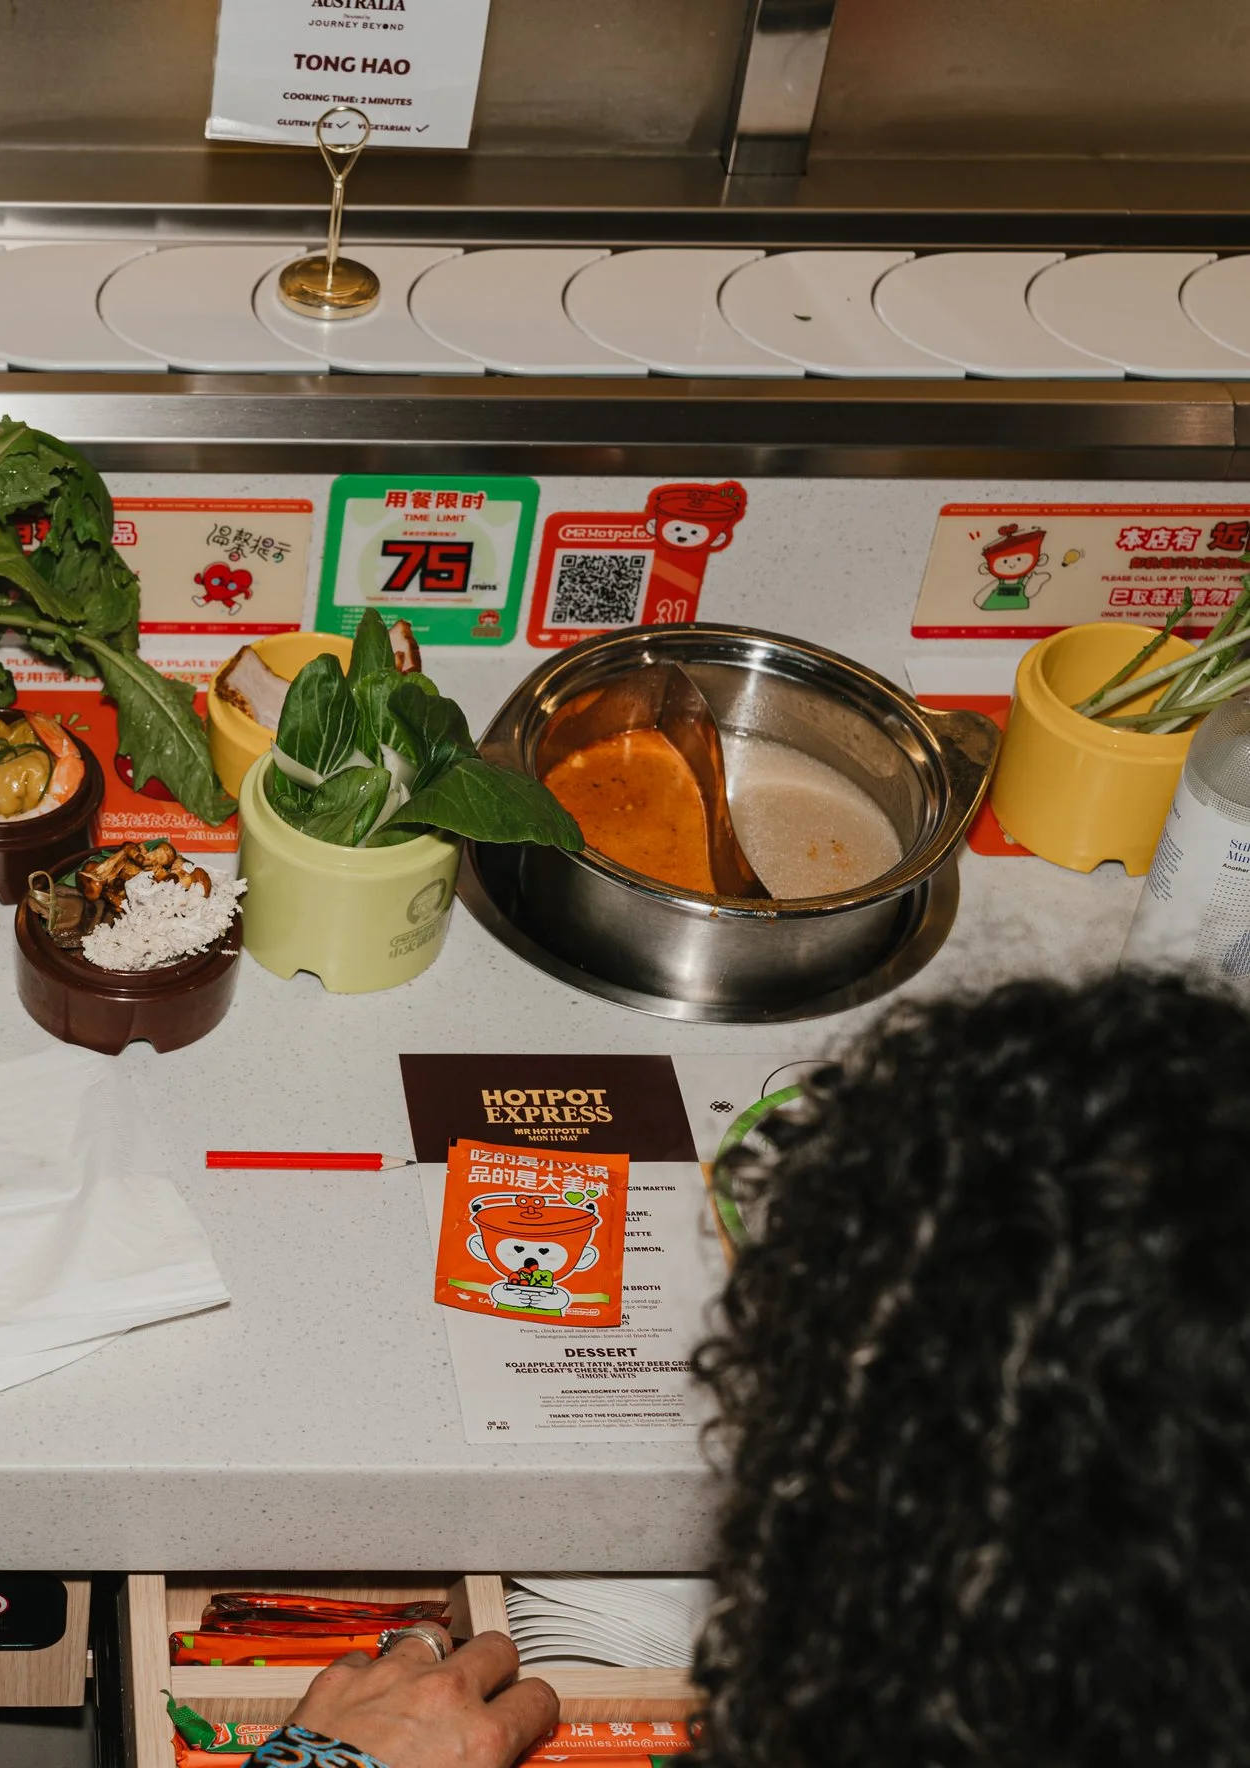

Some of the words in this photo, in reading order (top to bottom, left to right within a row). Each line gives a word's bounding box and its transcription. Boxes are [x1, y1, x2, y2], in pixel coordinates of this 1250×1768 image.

[311, 0, 406, 11] AUSTRALIA
[308, 20, 358, 28] JOURNEY
[362, 22, 404, 30] BEYOND
[293, 53, 356, 72] TONG
[361, 58, 411, 75] HAO
[283, 92, 330, 103] COOKING
[332, 94, 359, 104] TIME:
[360, 96, 367, 104] 2
[368, 97, 412, 106] MINUTES
[277, 119, 310, 128] GLUTEN
[311, 120, 333, 129] FEE
[384, 491, 485, 510] 用餐限时
[404, 514, 430, 522] TIME
[436, 514, 466, 523] LIMIT
[1116, 527, 1202, 551] 本店有
[381, 540, 474, 593] 75
[471, 582, 497, 591] mins
[653, 599, 687, 624] 31
[6, 658, 42, 666] PLEA
[185, 830, 205, 840] All
[1222, 863, 1250, 873] Another
[481, 1089, 607, 1106] HOTPOT
[484, 1106, 613, 1124] EXPRESS
[532, 1127, 590, 1135] HOTPOTER
[469, 1148, 609, 1179] 吃的是小火锅
[467, 1166, 609, 1198] 品的是大美味
[564, 1348, 638, 1358] DESSERT
